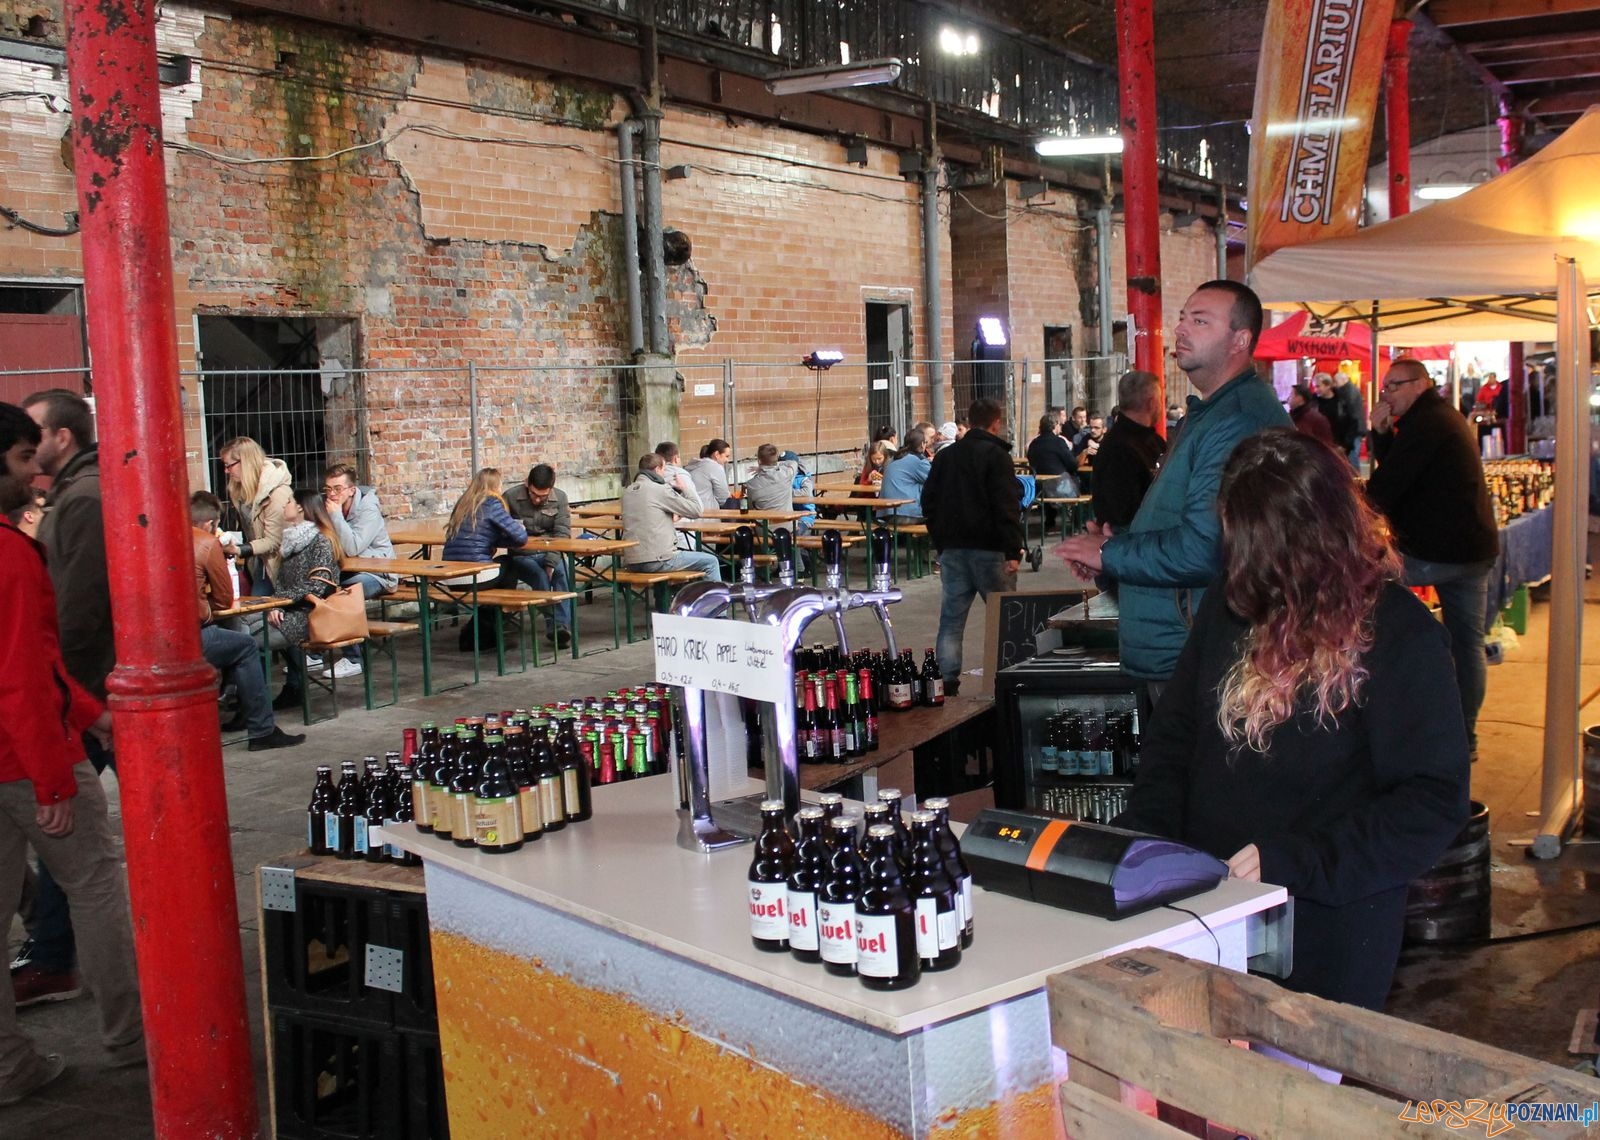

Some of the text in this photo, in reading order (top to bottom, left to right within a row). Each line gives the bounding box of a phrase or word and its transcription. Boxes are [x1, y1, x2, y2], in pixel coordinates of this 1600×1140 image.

[656, 636, 678, 657] FARO
[684, 639, 709, 663] KRIEK
[716, 643, 738, 663] APPLE
